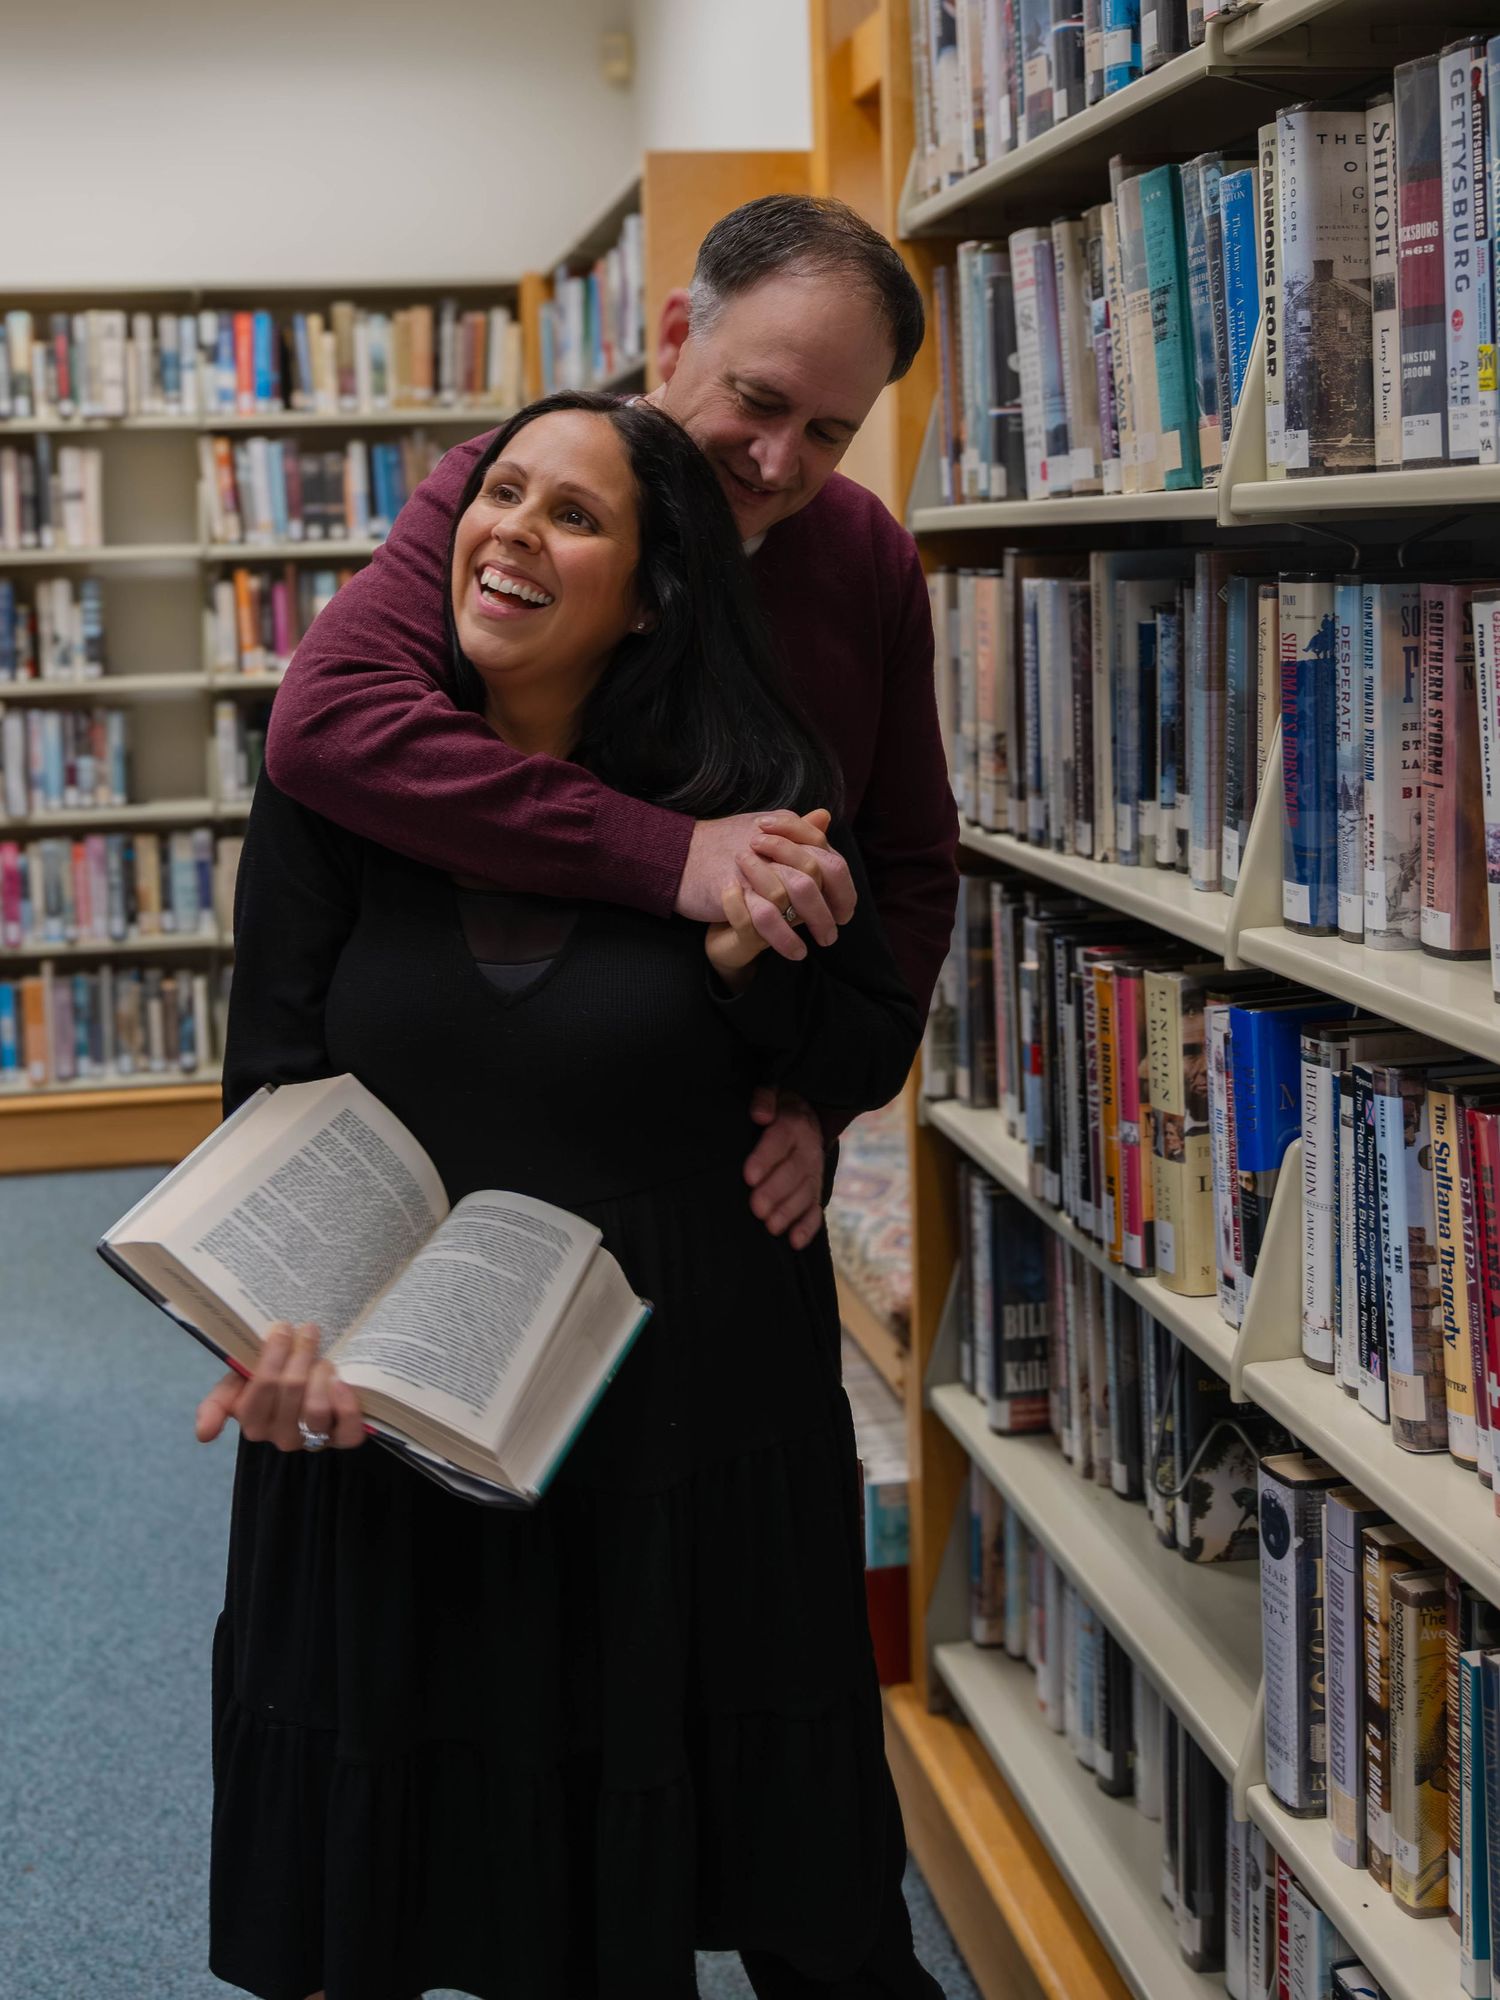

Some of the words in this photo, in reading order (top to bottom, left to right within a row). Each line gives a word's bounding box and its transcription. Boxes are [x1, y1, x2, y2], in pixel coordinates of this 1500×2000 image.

[1316, 134, 1367, 145] THE
[1472, 103, 1484, 180] GETTYSBURG
[1373, 121, 1391, 258] SHILOH
[1450, 67, 1470, 293] GETTYSBURG
[1261, 150, 1277, 288] CANNONS
[1290, 176, 1298, 244] COLORS
[1474, 183, 1485, 237] ADDRESS
[1210, 253, 1222, 295] TWO
[1232, 243, 1243, 273] Army
[1342, 255, 1371, 266] Marg
[1213, 299, 1226, 350] ROADS
[1264, 296, 1278, 378] ROAR
[1379, 328, 1390, 364] Larry
[1219, 372, 1233, 438] SUMTER
[1480, 438, 1493, 451] YA
[1363, 595, 1374, 670] SOMEWHERE
[1428, 600, 1444, 703] SOUTHERN
[1477, 623, 1485, 658] FROM
[1281, 632, 1298, 733] SHERMAN'S
[1340, 625, 1351, 743] DESPERATE
[1364, 675, 1375, 725] TOWARD
[1479, 662, 1488, 711] VICTORY
[1226, 679, 1236, 753] CALCULUS
[1427, 707, 1444, 777] STORM
[1482, 716, 1489, 732] TO
[1364, 729, 1376, 782] FREEDOM
[1483, 735, 1492, 798] COLLAPSE
[1426, 826, 1437, 861] ANDRE
[1100, 1007, 1110, 1035] THE
[1159, 990, 1170, 1102] LINCOLN
[1102, 1042, 1113, 1106] BROKEN
[1151, 1019, 1160, 1089] DAVIS
[1305, 1068, 1318, 1127] REIGN
[1356, 1089, 1364, 1112] The
[1433, 1103, 1448, 1136] The
[1305, 1131, 1316, 1149] of
[1357, 1117, 1367, 1158] "Real
[1367, 1135, 1375, 1192] Treasures
[1305, 1151, 1317, 1198] IRON
[1358, 1161, 1367, 1205] Rhett
[1368, 1194, 1376, 1208] of
[1433, 1140, 1454, 1241] Sultana
[1304, 1209, 1316, 1250] JAMES
[1359, 1207, 1369, 1260] Butler"
[1368, 1210, 1376, 1229] the
[1379, 1152, 1392, 1269] GREATEST
[1460, 1176, 1477, 1286] ELMIRA
[1369, 1231, 1378, 1304] Confederate
[1394, 1244, 1403, 1274] THE
[1304, 1263, 1316, 1309] NELSON
[1359, 1274, 1368, 1309] Other
[1440, 1245, 1461, 1351] Tragedy
[1370, 1305, 1380, 1346] Coast:
[1384, 1274, 1396, 1361] ESCAPE
[1471, 1302, 1480, 1342] DEATH
[1473, 1343, 1483, 1377] CAMP
[1365, 1543, 1380, 1579] THE
[1329, 1568, 1345, 1613] OUR
[1365, 1580, 1381, 1626] LAST
[1329, 1611, 1345, 1664] MAN
[1420, 1613, 1447, 1627] The
[1366, 1621, 1382, 1704] CAMPAIGN
[1394, 1601, 1407, 1716] econstruction:
[1446, 1670, 1460, 1723] MORE
[1461, 1663, 1472, 1730] AMERICAN
[1446, 1724, 1460, 1764] WAR
[1462, 1732, 1472, 1790] POPULISM
[1447, 1766, 1460, 1793] TO
[1447, 1794, 1461, 1849] FIGHT
